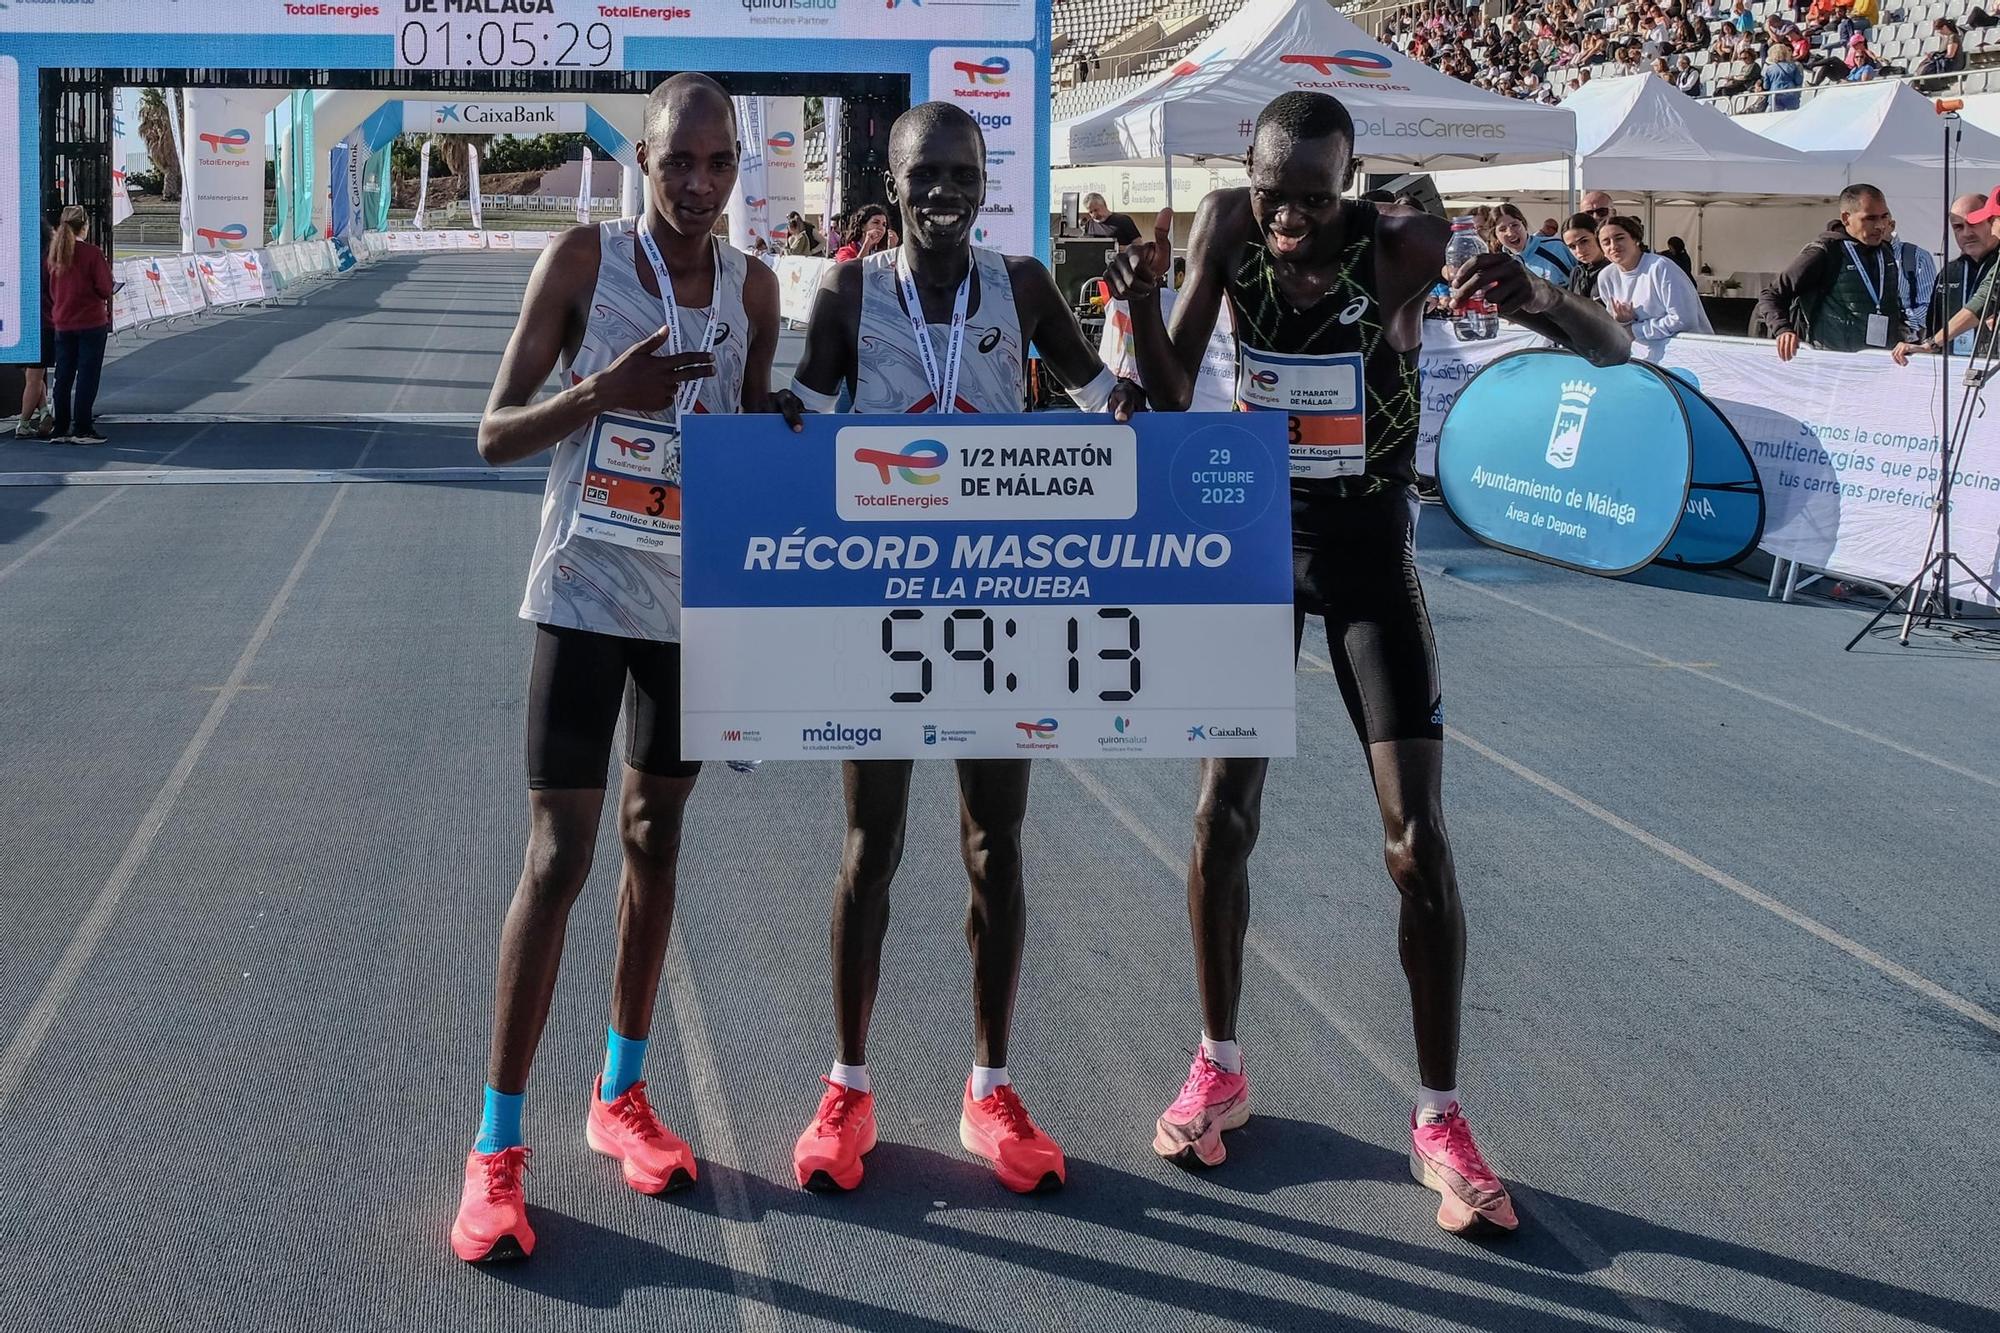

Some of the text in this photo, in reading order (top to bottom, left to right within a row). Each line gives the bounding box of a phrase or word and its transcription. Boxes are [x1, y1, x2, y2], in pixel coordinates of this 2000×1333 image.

[284, 4, 379, 18] TotalEnergies
[405, 0, 438, 13] DE
[598, 5, 690, 20] TotalEnergies
[402, 21, 612, 67] 01:05:29
[954, 89, 1010, 99] TotalEnergies
[1295, 80, 1411, 93] TotalEnergies
[464, 104, 555, 123] CaixaBank
[199, 158, 250, 167] TotalEnergies
[350, 143, 360, 207] CaixaBank
[1302, 388, 1339, 396] MARATÓN
[1801, 421, 1849, 441] Somos
[1854, 427, 1867, 443] la
[960, 443, 1112, 467] 1/2 MARATÓN
[1209, 449, 1231, 464] 29
[1754, 440, 1876, 471] multienergías
[1881, 460, 1912, 478] que
[607, 458, 651, 472] TotalEnergies
[961, 473, 1095, 496] DE MÁLAGA
[1192, 472, 1254, 483] OCTUBRE
[1778, 470, 1799, 488] tus
[1804, 476, 1864, 497] carreras
[645, 486, 667, 516] 3
[855, 494, 949, 509] TotalEnergies
[1201, 488, 1245, 504] 2023
[1471, 465, 1636, 525] Ayuntamiento de Málaga
[610, 510, 681, 530] Boniface Kibiwo
[1505, 501, 1587, 539] Área de Deporte
[744, 527, 1232, 570] RÉCORD MASCULINO
[885, 576, 1091, 599] DE LA PRUEBA
[881, 607, 1141, 703] 59:13
[1209, 726, 1258, 737] CaixaBank
[1016, 742, 1059, 750] TotalEnergies
